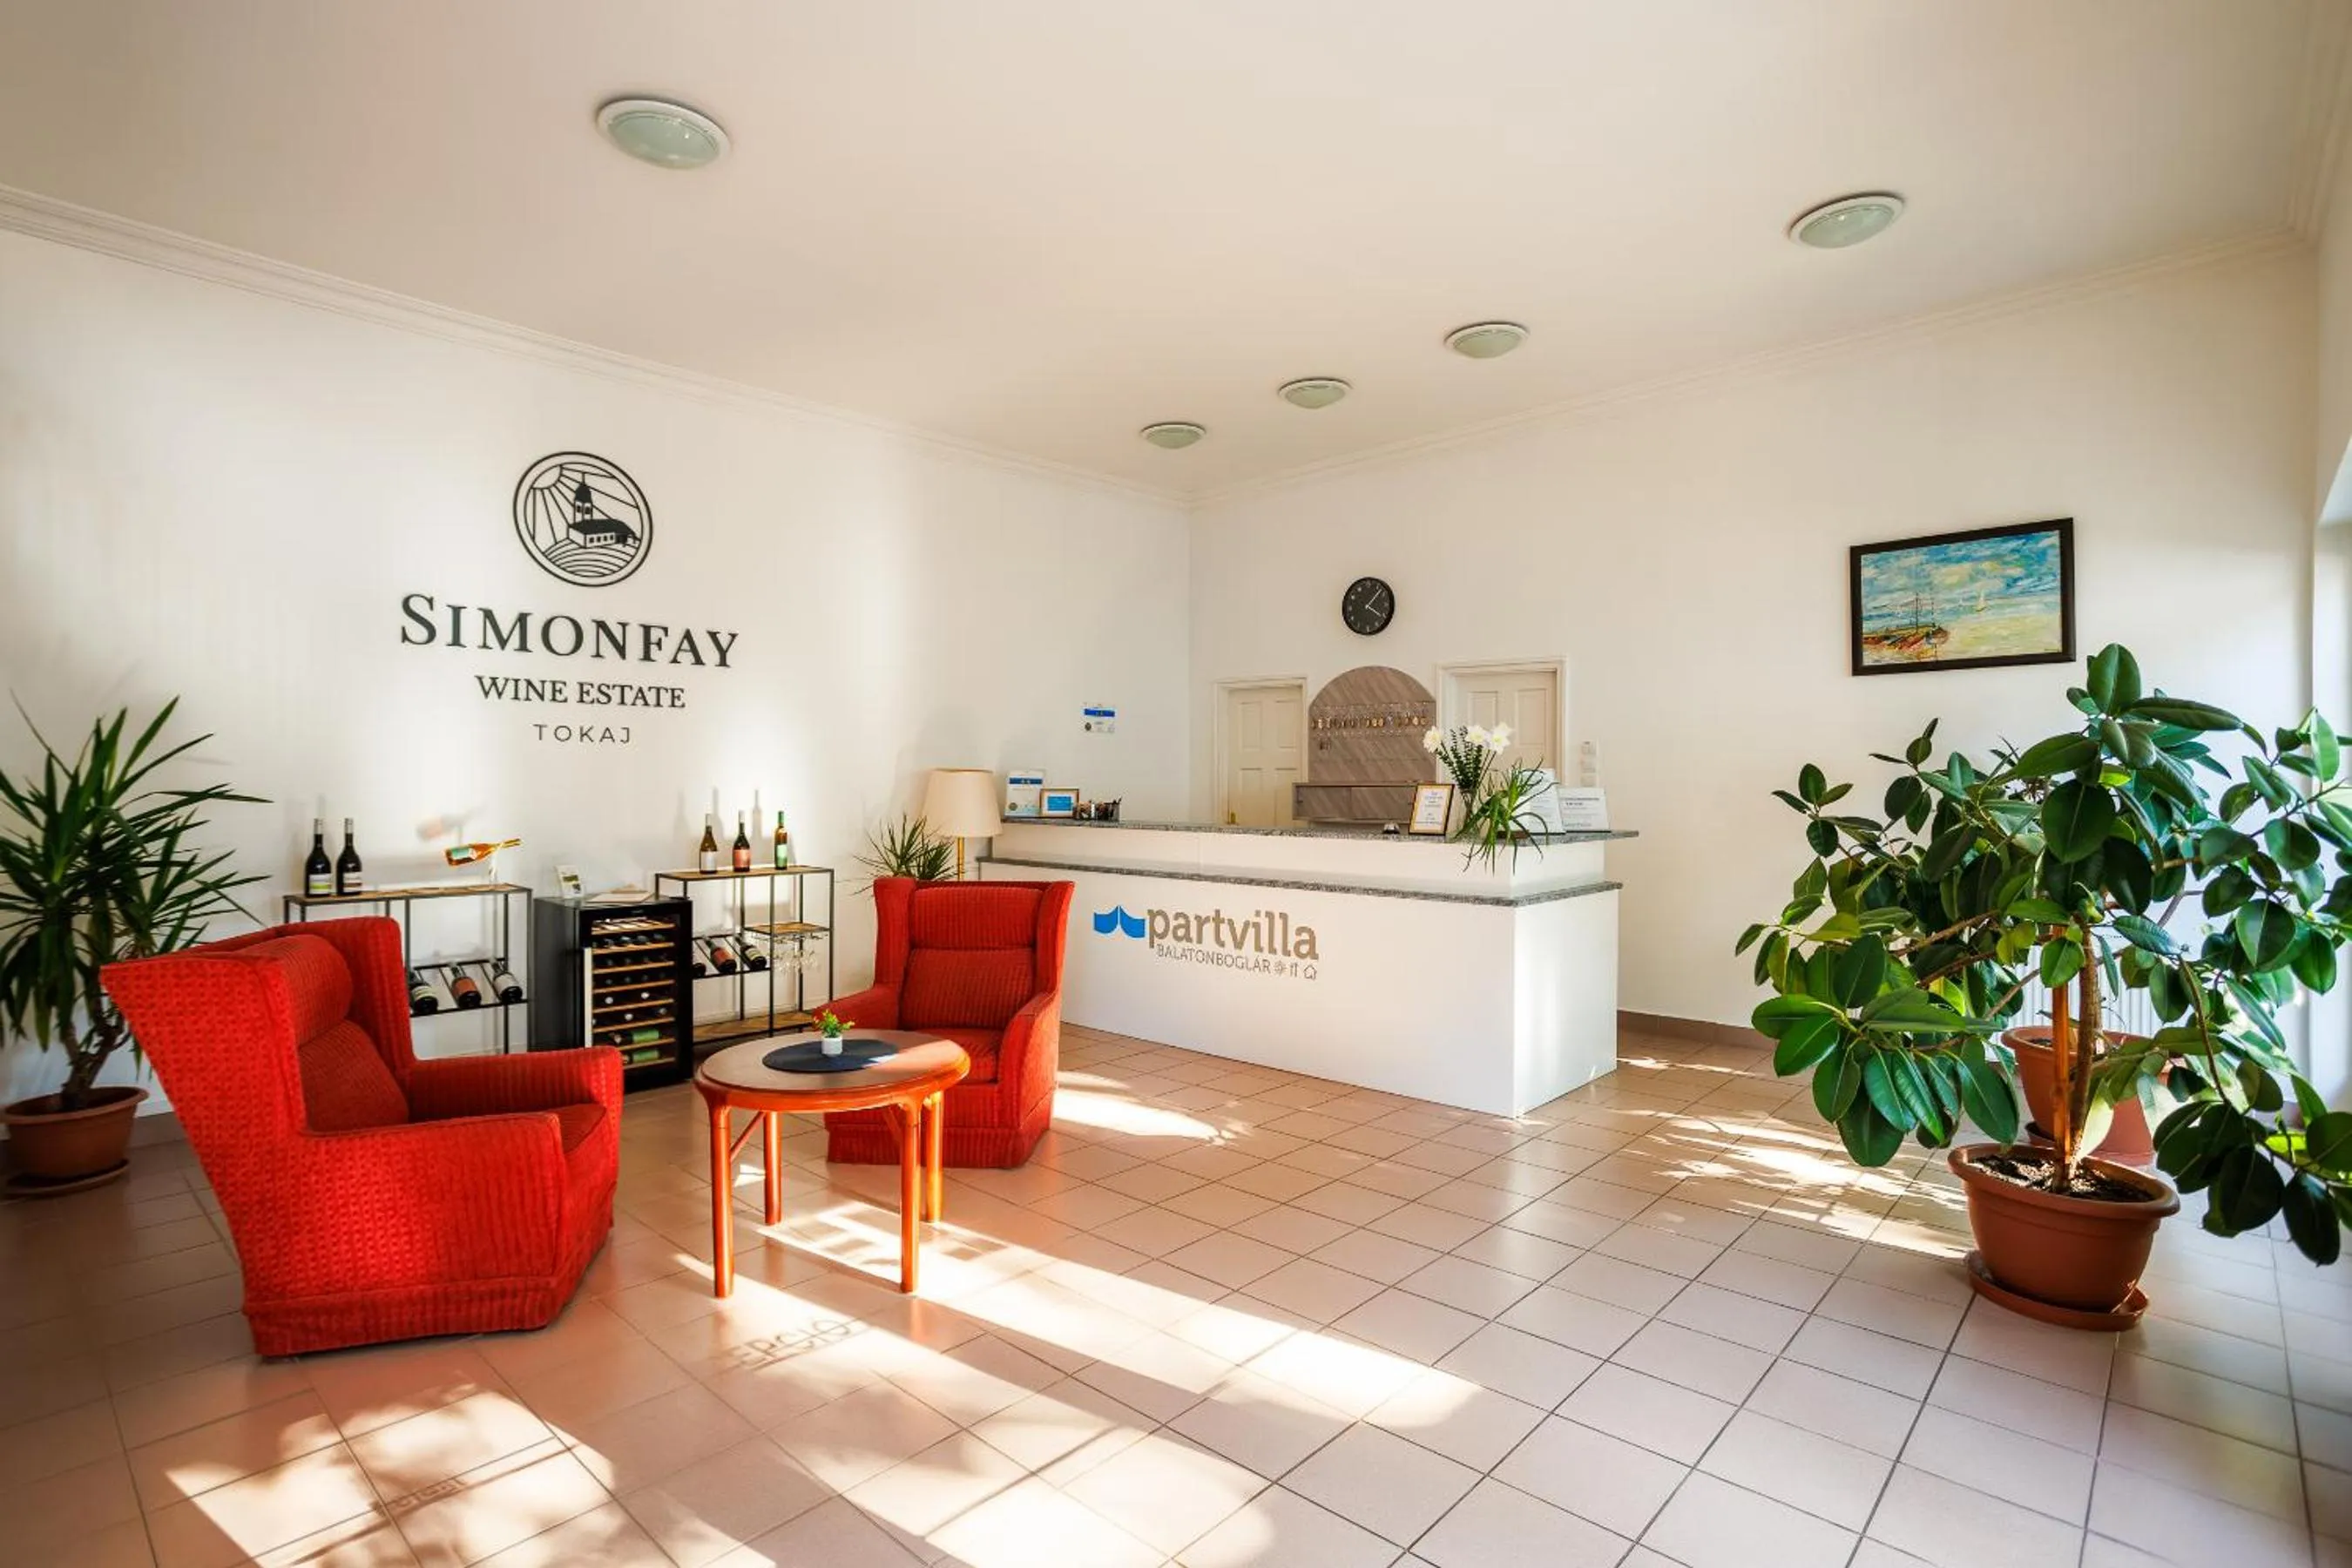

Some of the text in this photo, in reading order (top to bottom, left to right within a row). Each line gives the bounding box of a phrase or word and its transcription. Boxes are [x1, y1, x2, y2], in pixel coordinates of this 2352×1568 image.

[400, 592, 740, 668] SIMONFAY
[474, 675, 686, 709] WINE ESTATE
[533, 724, 632, 744] TOKAJ
[1146, 908, 1320, 961] partvilla
